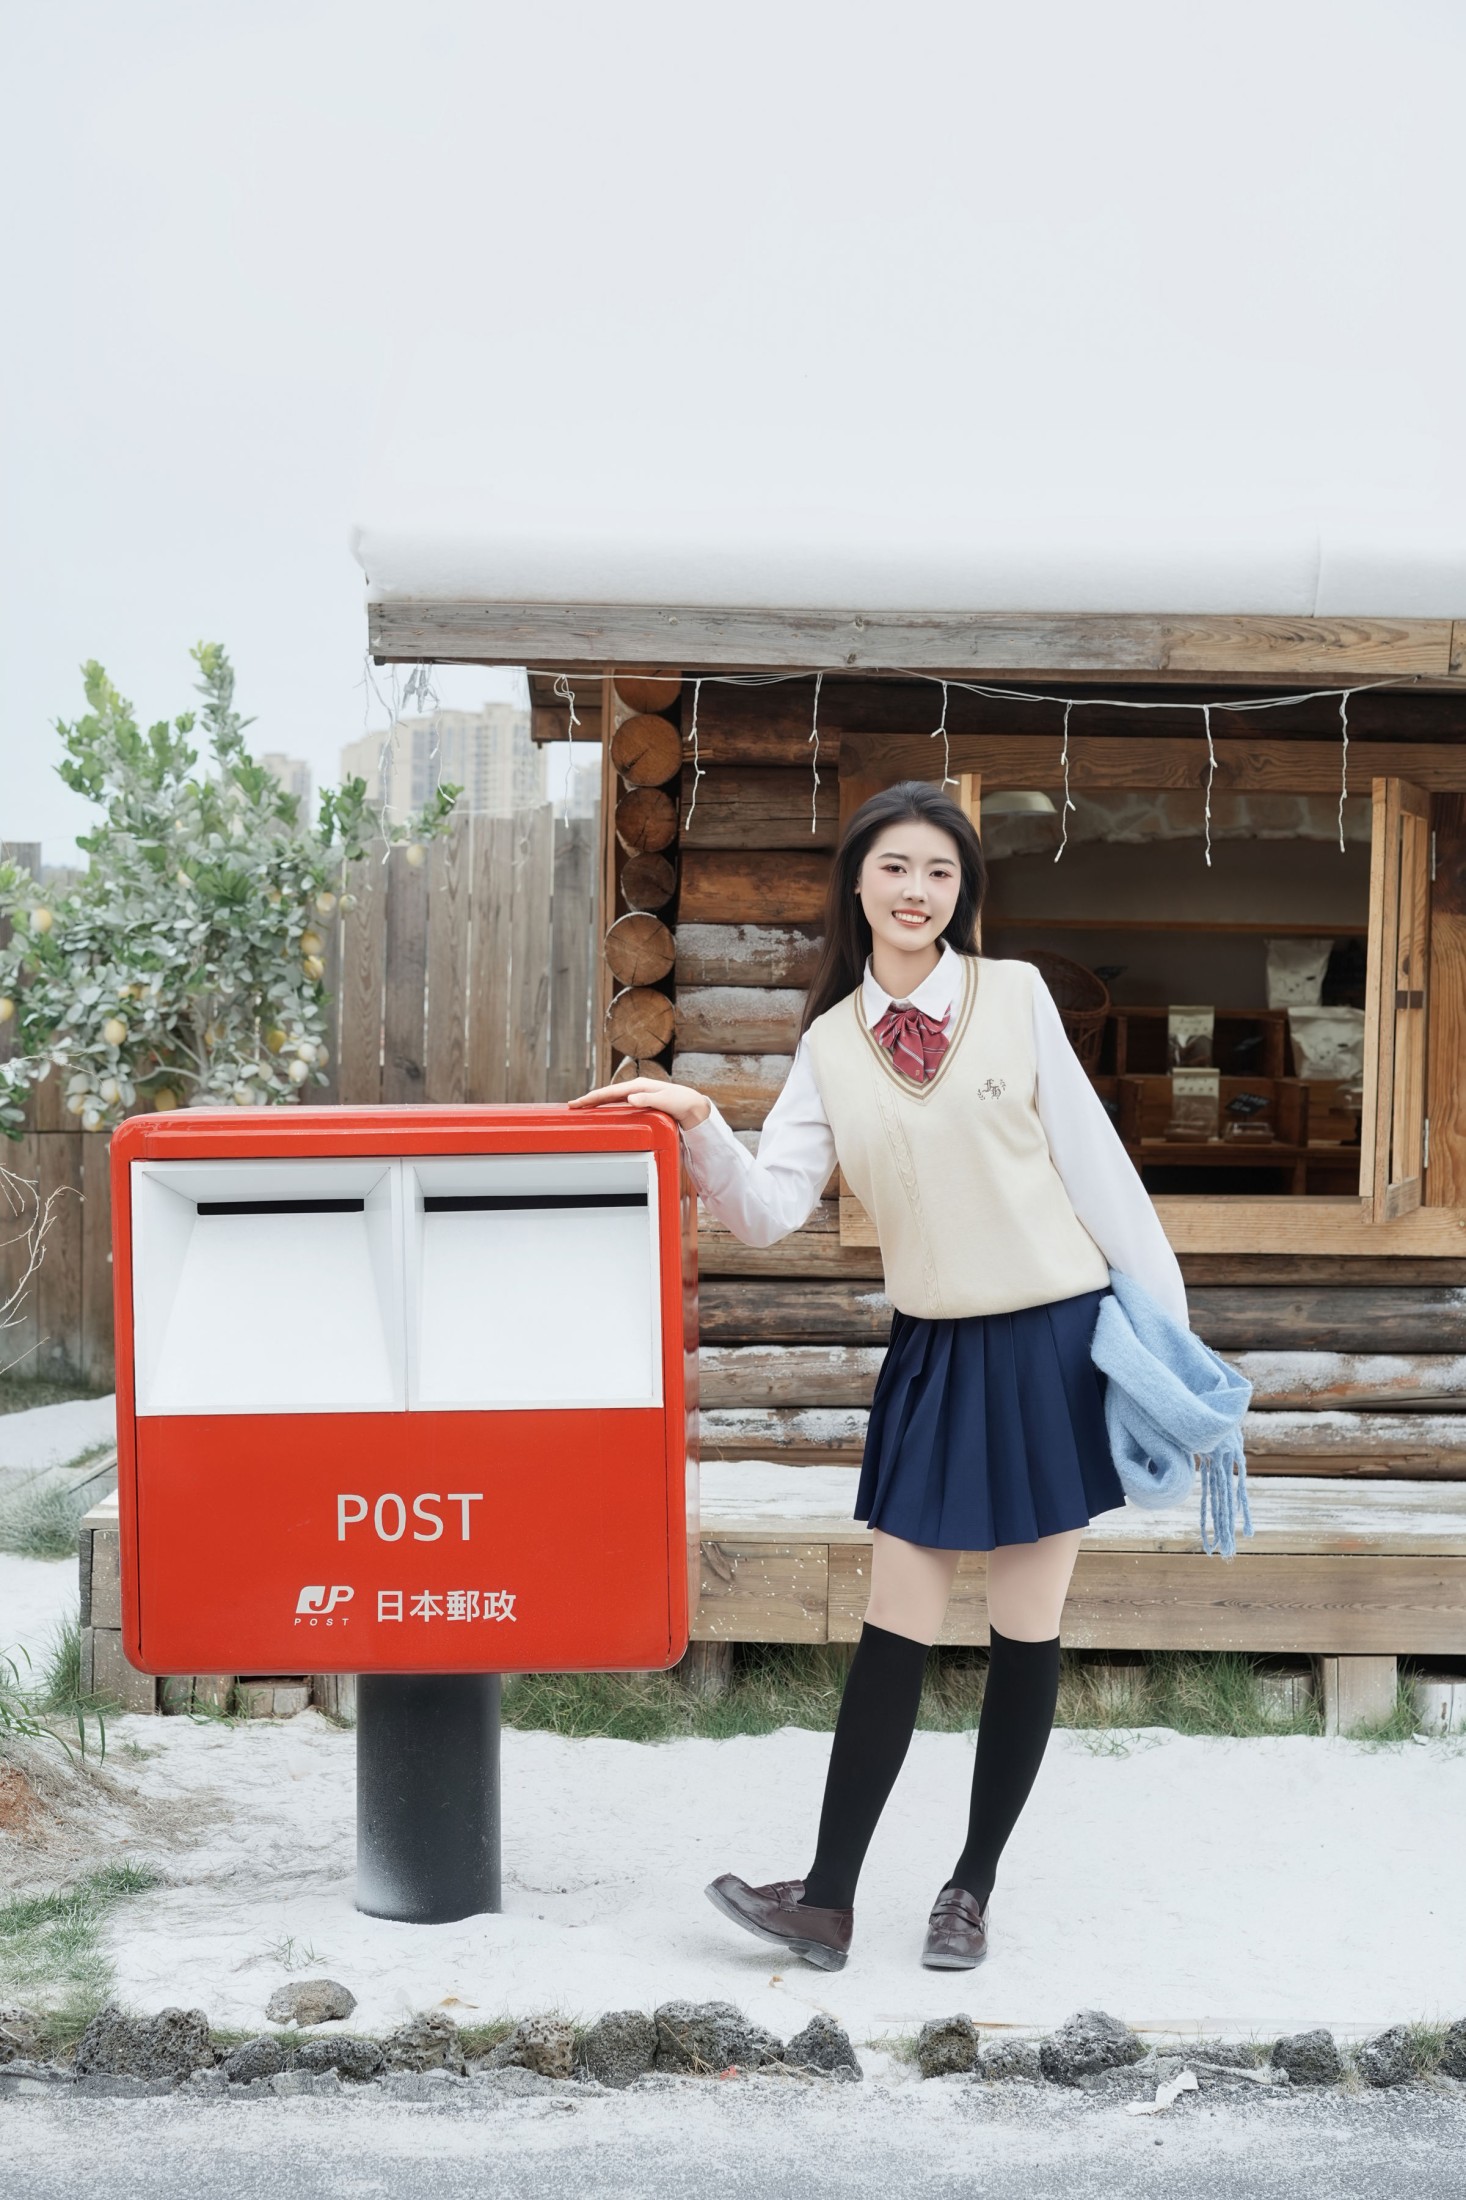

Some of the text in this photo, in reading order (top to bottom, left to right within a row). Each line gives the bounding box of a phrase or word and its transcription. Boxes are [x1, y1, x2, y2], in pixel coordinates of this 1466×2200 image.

[337, 1493, 484, 1542] POST
[295, 1585, 355, 1615] JP
[377, 1589, 518, 1623] 日本郵政
[294, 1618, 351, 1626] POST
